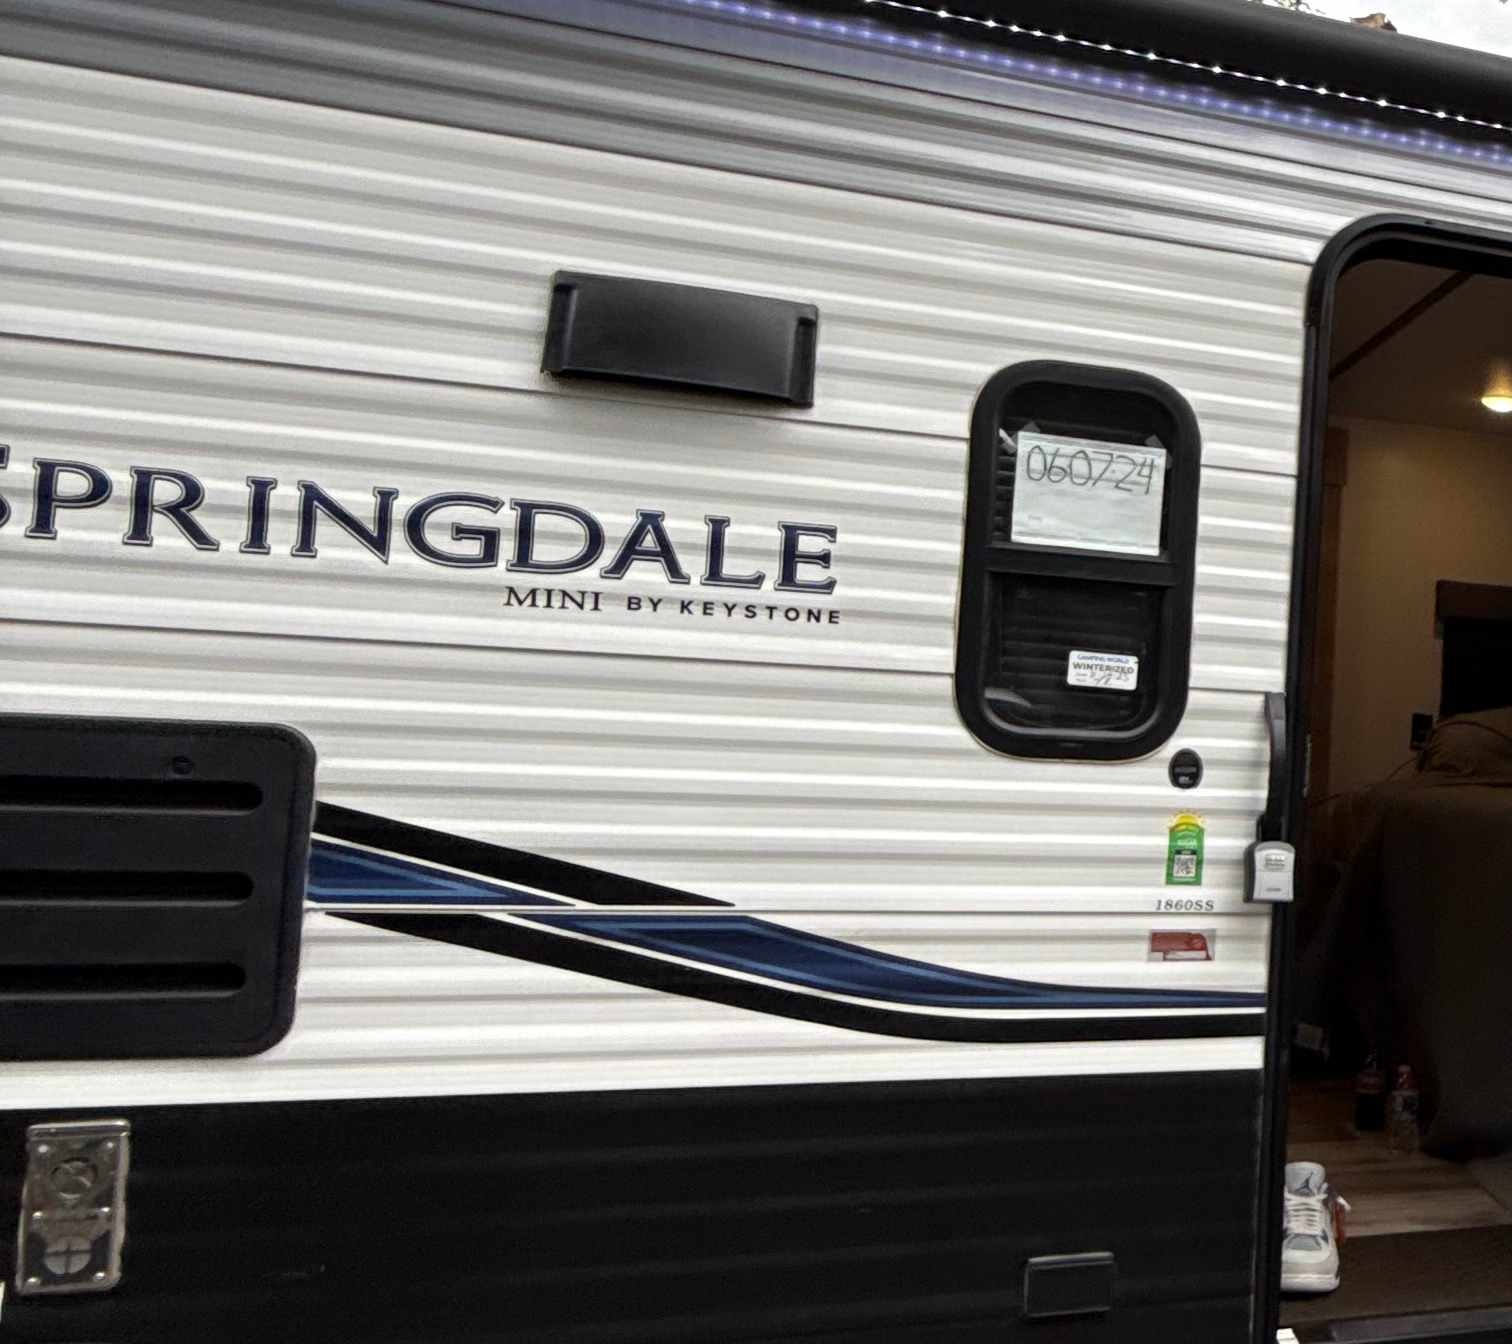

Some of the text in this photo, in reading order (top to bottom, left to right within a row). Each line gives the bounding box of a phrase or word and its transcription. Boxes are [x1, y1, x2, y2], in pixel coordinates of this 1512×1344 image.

[0, 444, 839, 594] PRINGDALE
[503, 586, 841, 625] MINI BY KEYSTONE
[1072, 661, 1135, 676] WINTERIZED
[1155, 898, 1215, 912] 1860SS
